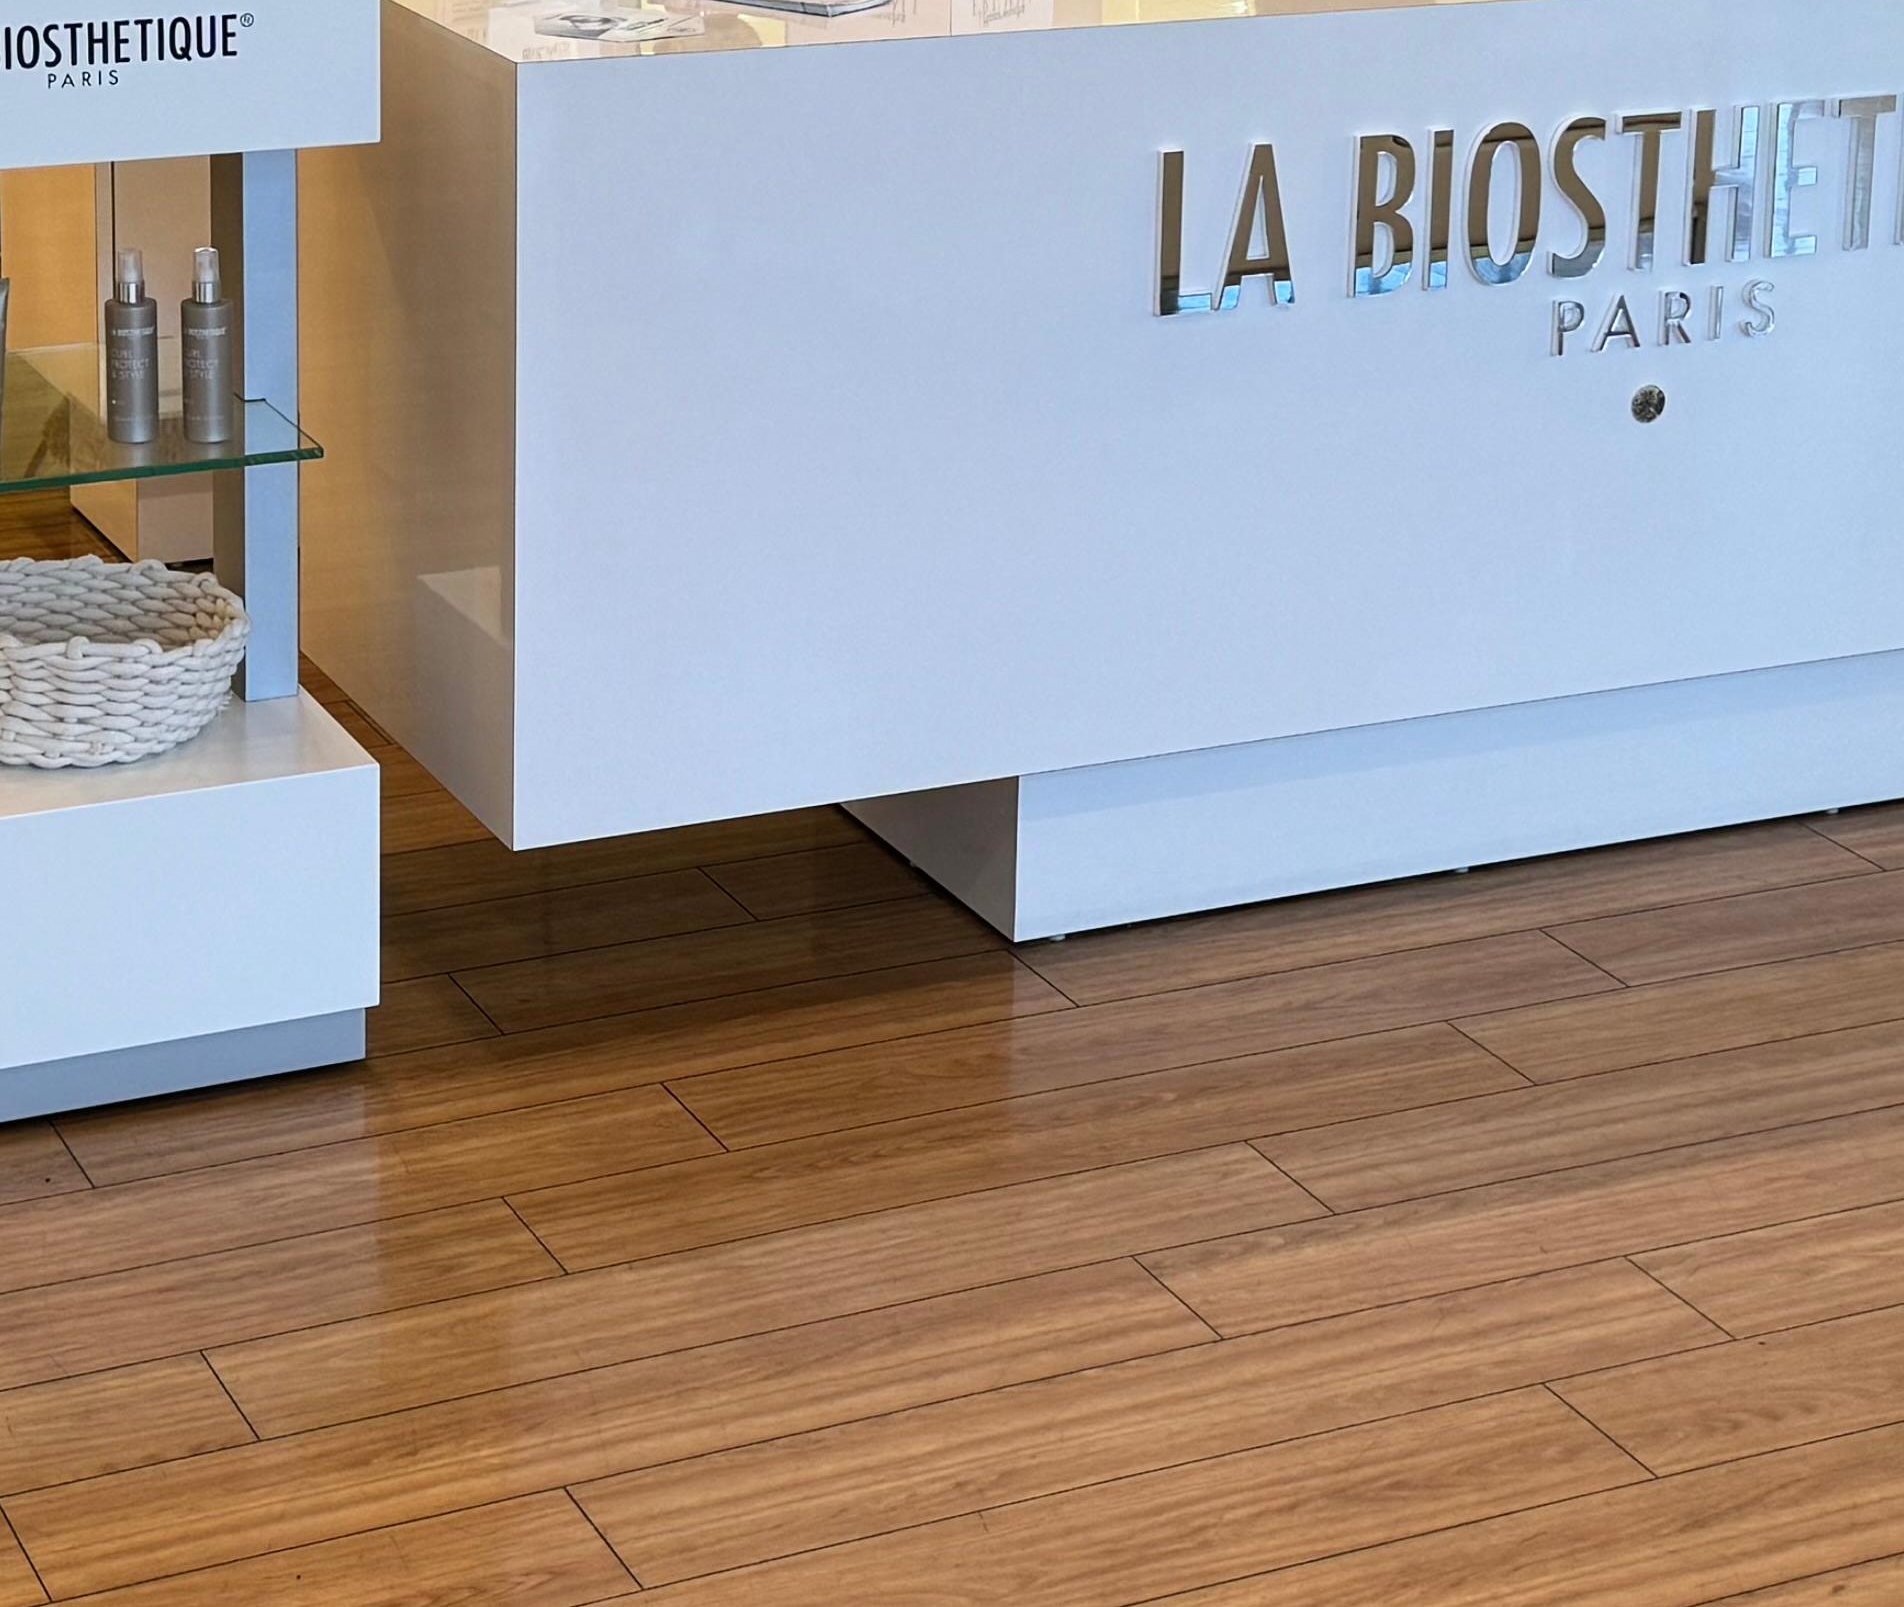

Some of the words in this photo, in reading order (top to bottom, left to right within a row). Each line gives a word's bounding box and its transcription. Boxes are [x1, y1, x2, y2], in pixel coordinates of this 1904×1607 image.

[47, 69, 119, 90] PARIS
[1153, 142, 1296, 317] LA
[1550, 278, 1777, 357] PARIS
